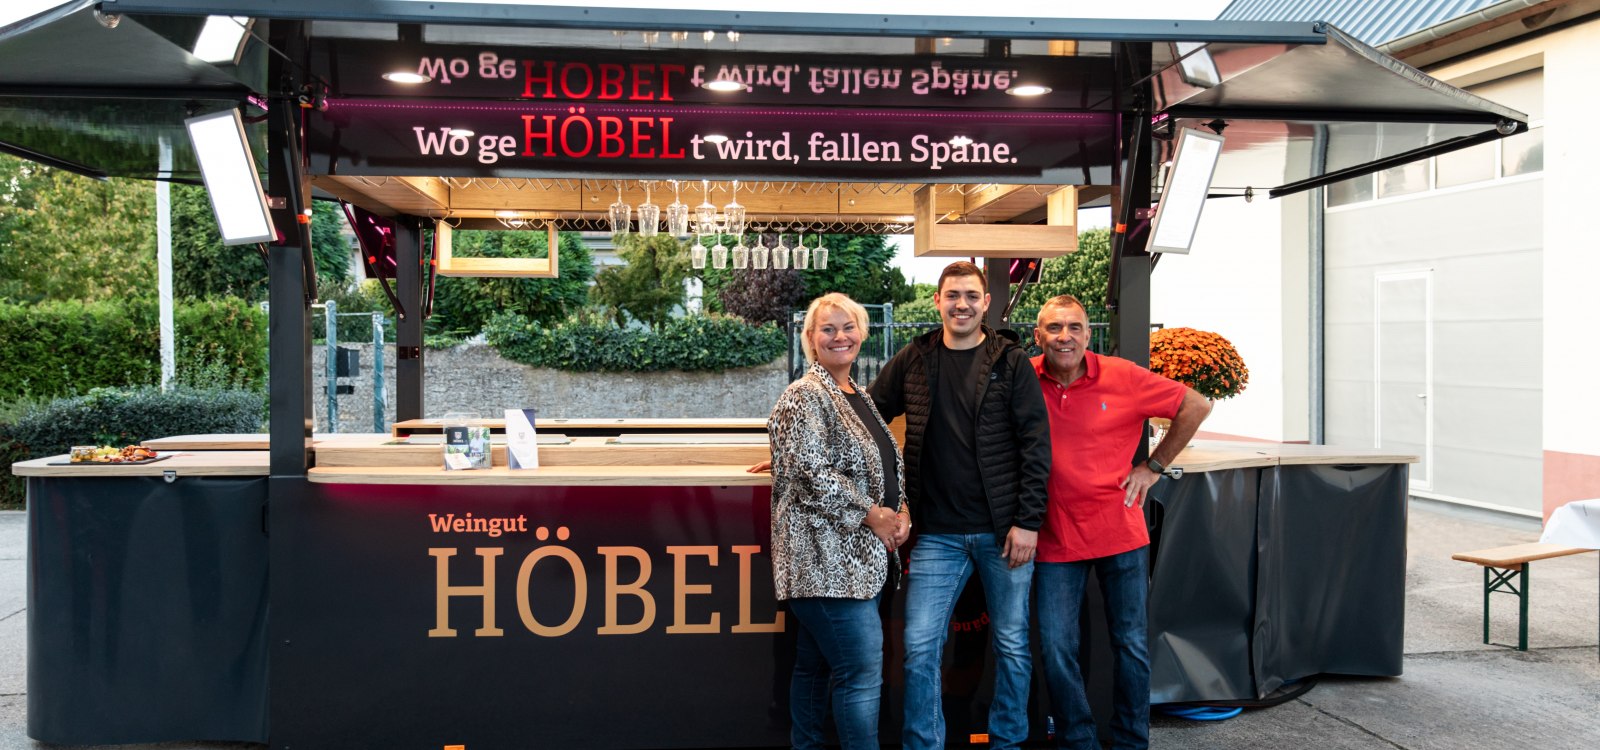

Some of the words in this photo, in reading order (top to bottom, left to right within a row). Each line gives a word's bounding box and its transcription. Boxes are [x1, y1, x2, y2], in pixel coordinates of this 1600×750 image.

[413, 127, 470, 156] Wo
[715, 131, 800, 165] wird,
[808, 132, 902, 162] fallen
[910, 135, 1018, 170] Späne.
[428, 512, 528, 538] Weingut
[428, 526, 786, 638] HÖBEL
